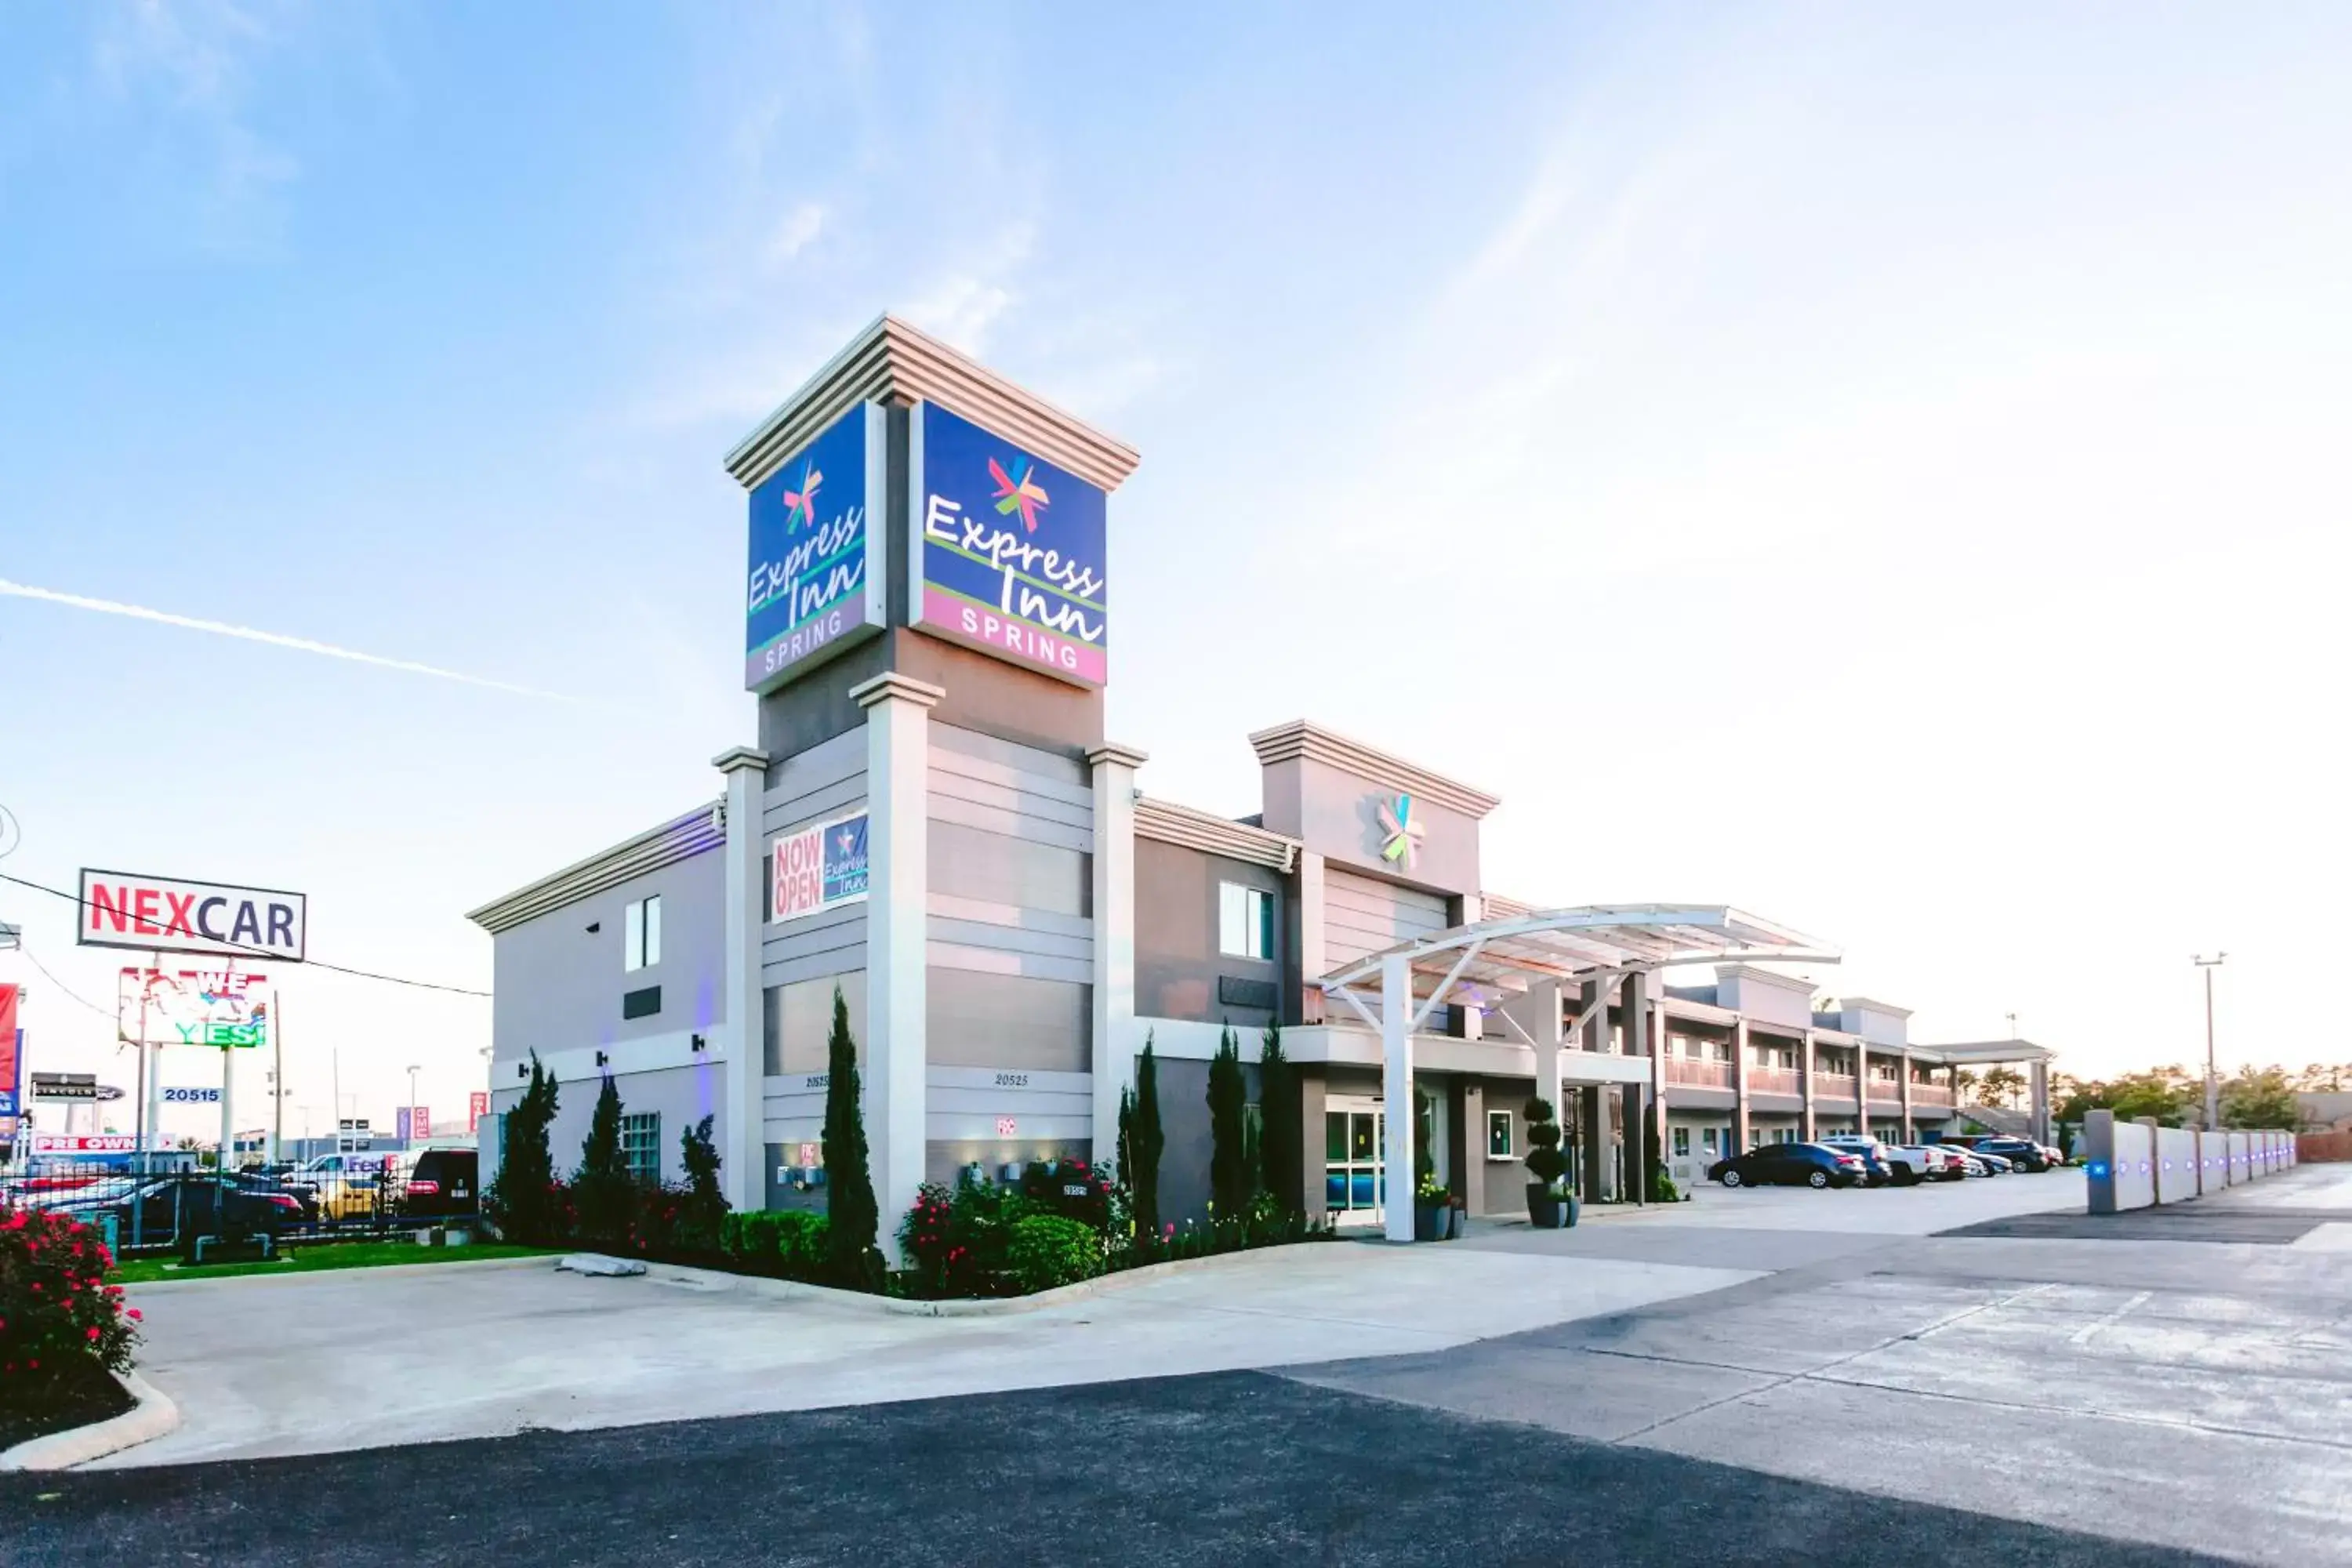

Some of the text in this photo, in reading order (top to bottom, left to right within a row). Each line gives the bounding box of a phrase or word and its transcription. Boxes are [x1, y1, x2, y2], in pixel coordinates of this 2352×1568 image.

[749, 506, 864, 611] Express
[926, 494, 1103, 597] Express
[789, 557, 864, 630] Inn
[1001, 564, 1103, 641] Inn
[764, 610, 842, 673] SPRING
[961, 608, 1077, 669] SPRING
[777, 832, 821, 878] NOW
[91, 884, 294, 948] NEXCAR
[776, 868, 821, 916] OPEN
[198, 972, 248, 993] WE
[165, 1089, 219, 1101] 20515
[994, 1073, 1029, 1086] 20525
[37, 1138, 79, 1149] PRE
